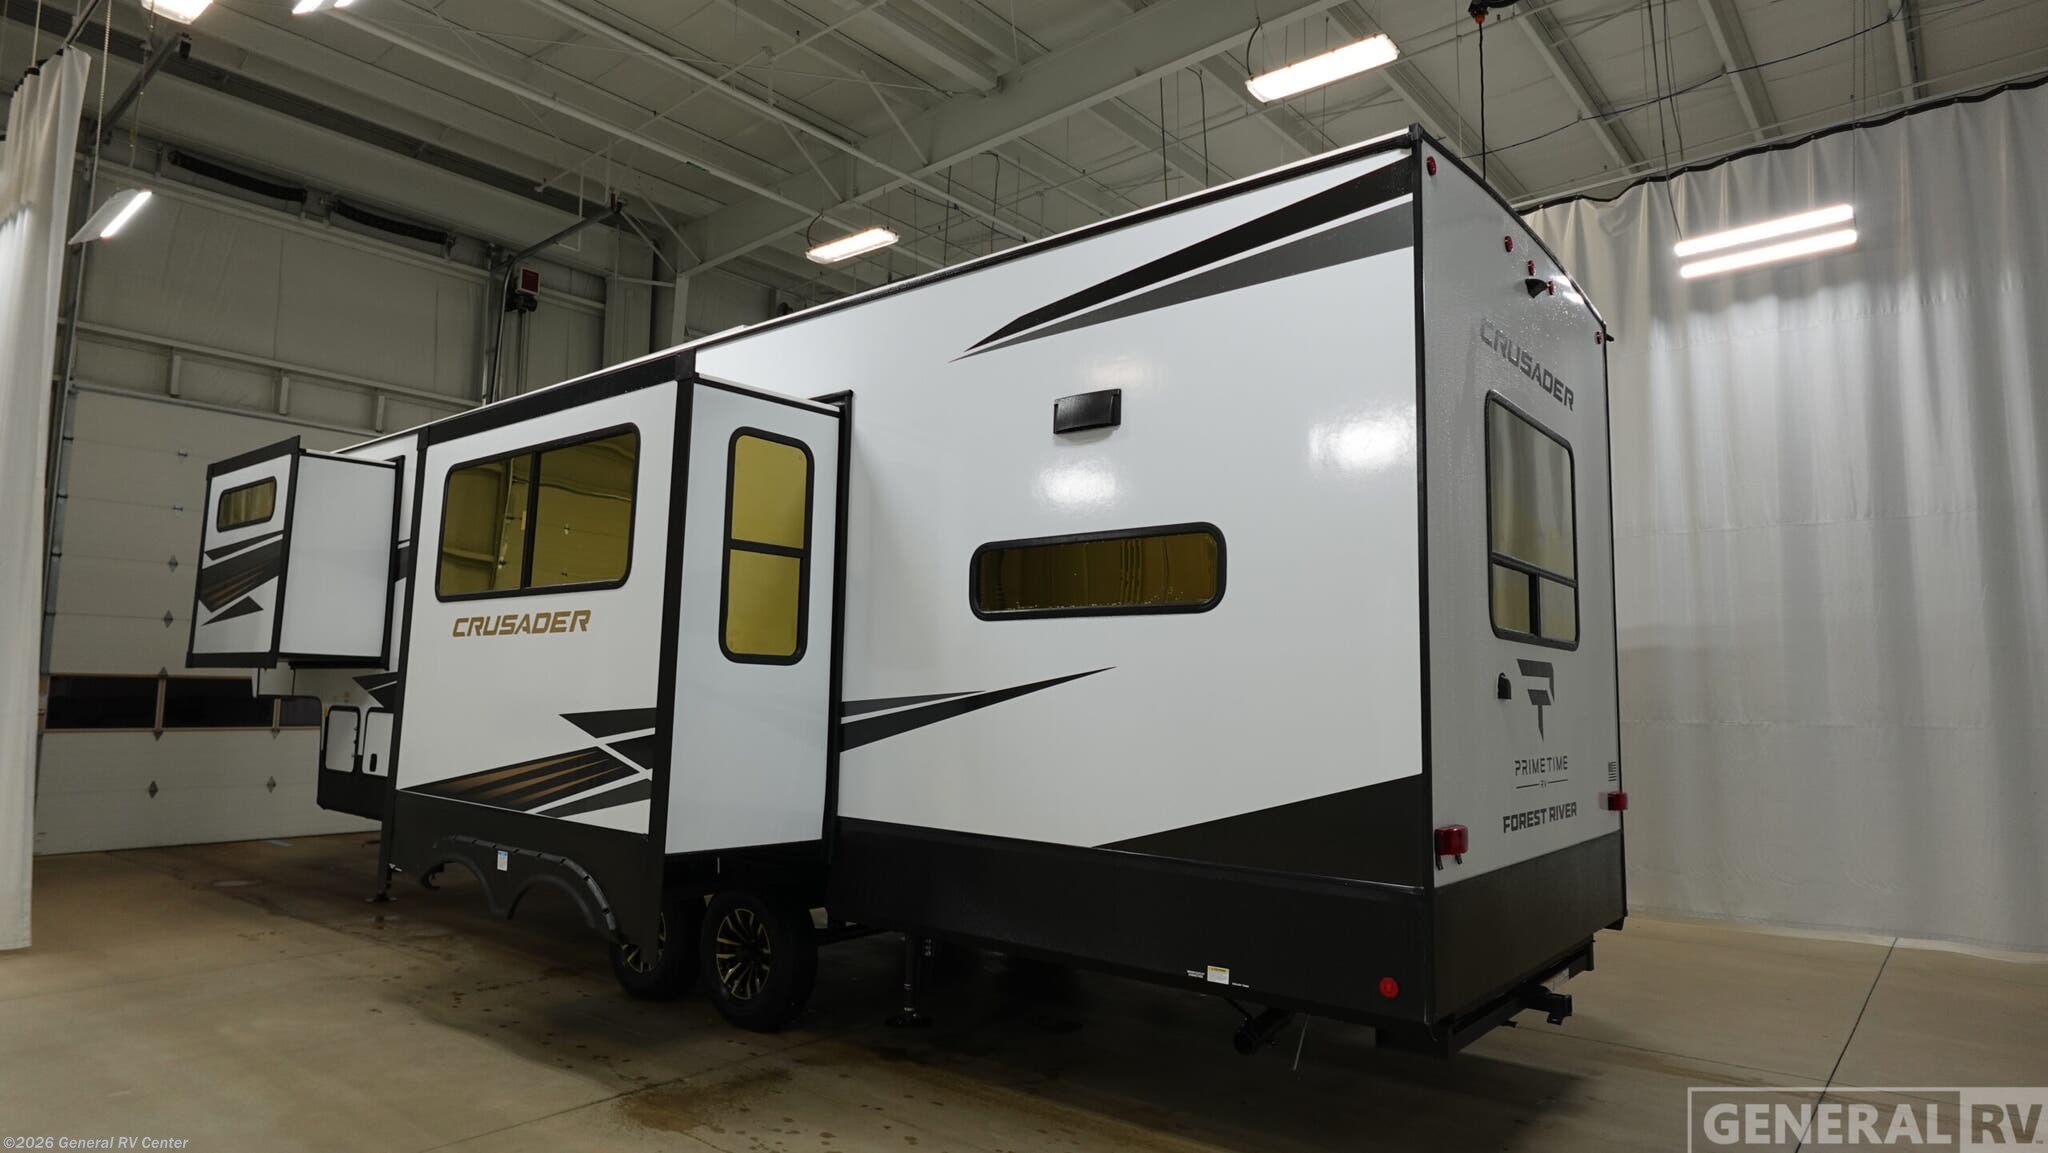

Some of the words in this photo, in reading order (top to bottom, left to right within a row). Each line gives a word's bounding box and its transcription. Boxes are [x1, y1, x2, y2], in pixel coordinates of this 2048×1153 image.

[1480, 318, 1574, 412] CRUSADER
[452, 609, 591, 637] CRUSADER
[1502, 808, 1547, 834] FOREST
[1549, 801, 1577, 823] RIVER
